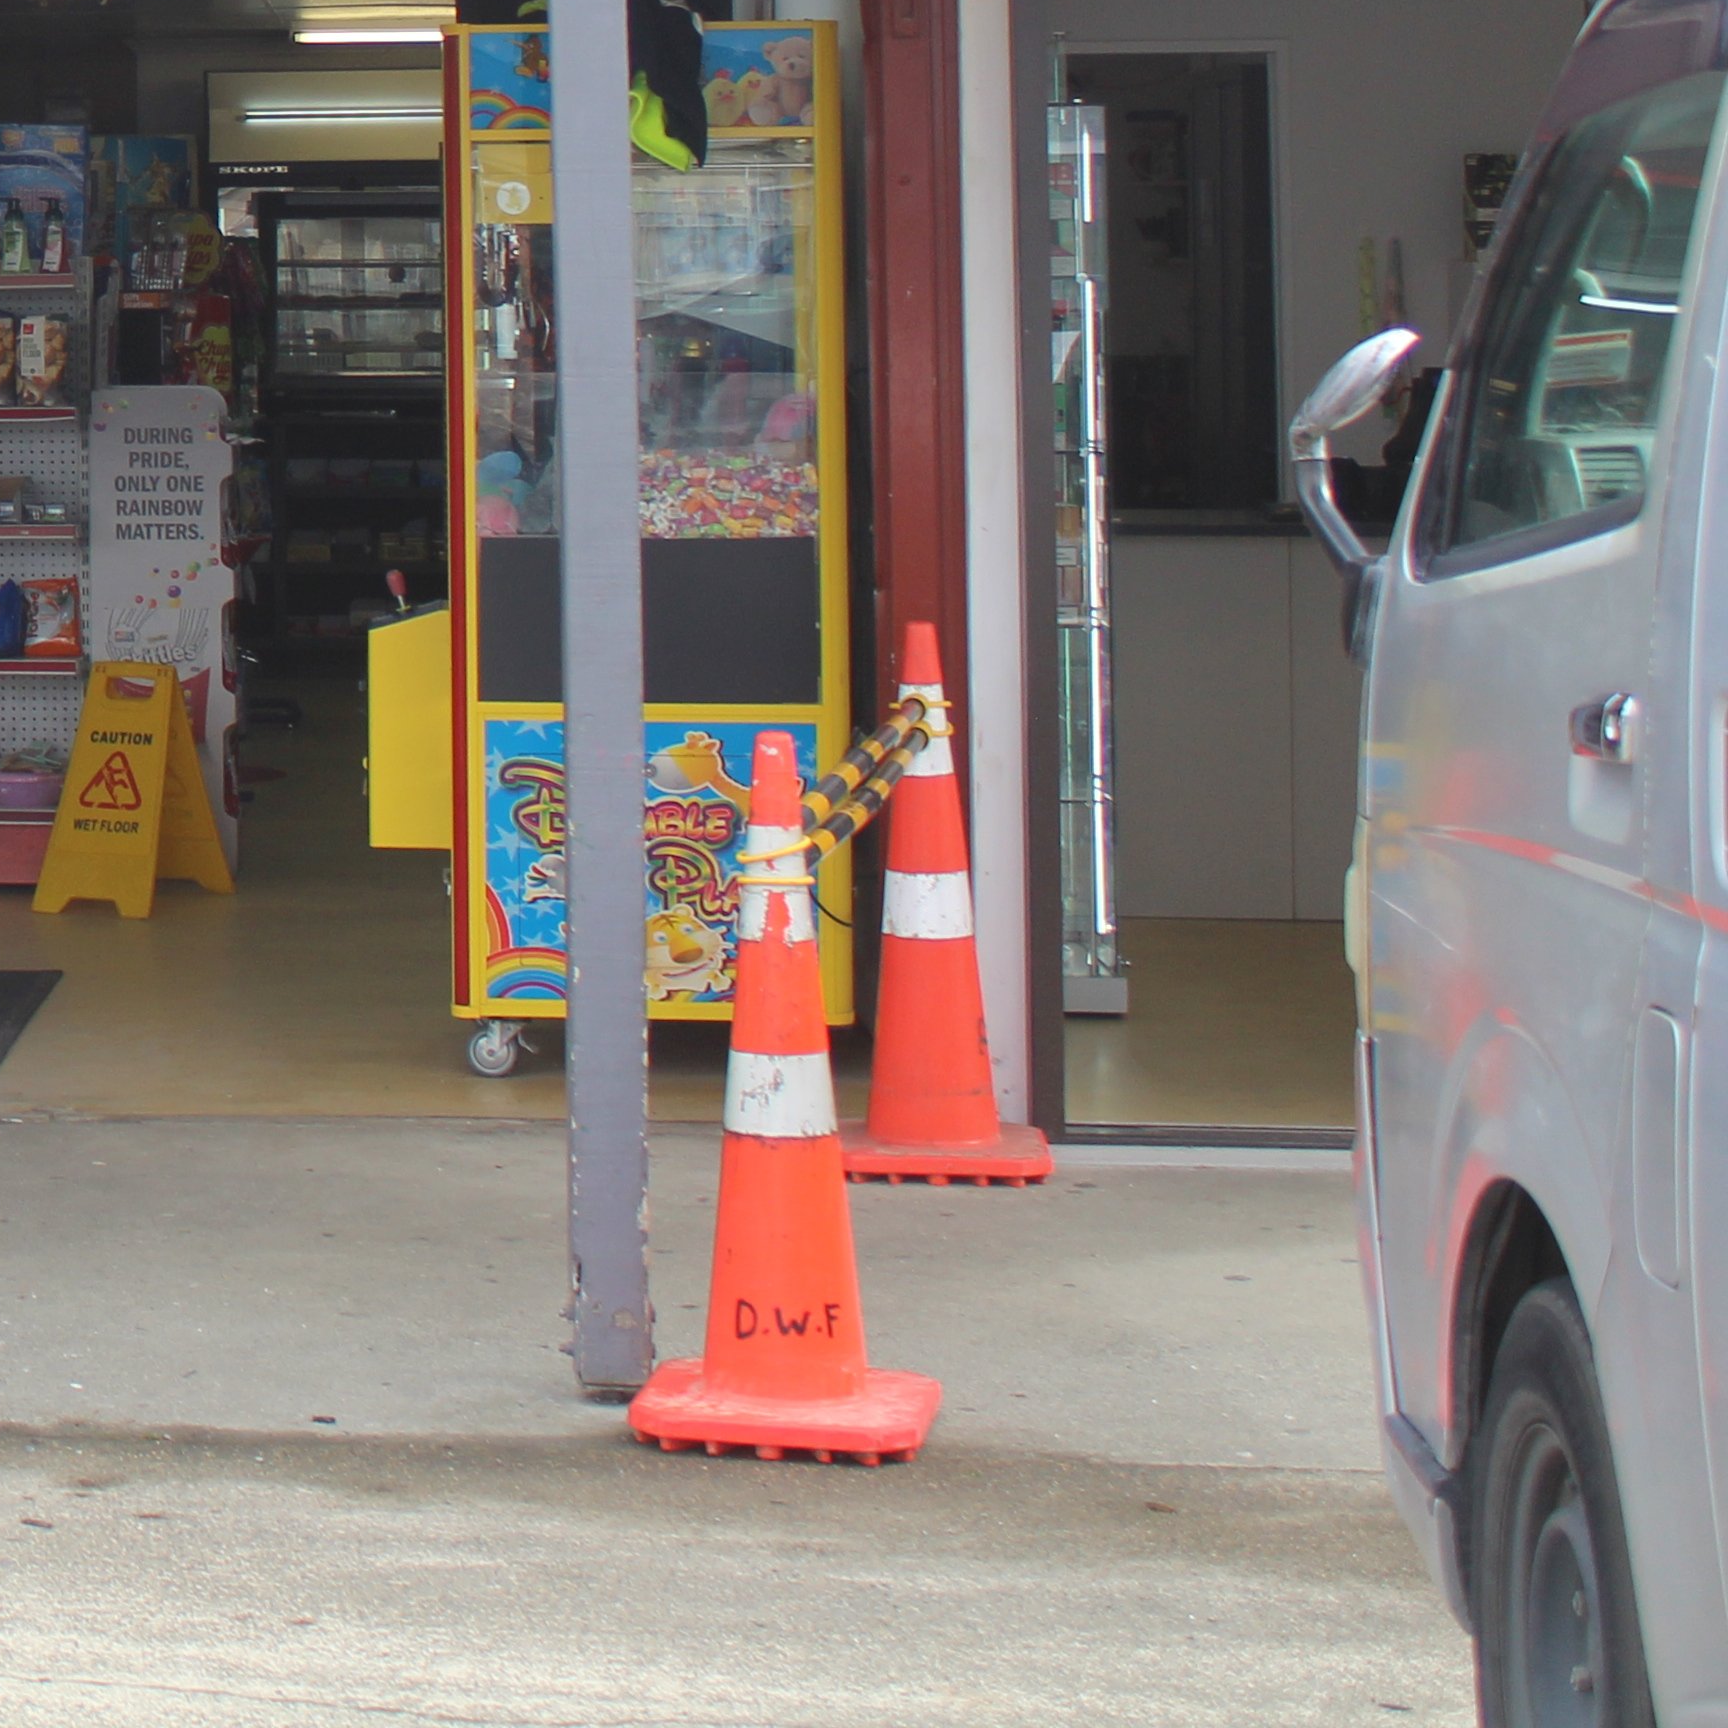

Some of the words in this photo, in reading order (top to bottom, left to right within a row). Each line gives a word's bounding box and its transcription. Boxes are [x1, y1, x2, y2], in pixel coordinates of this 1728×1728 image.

[123, 428, 193, 445] DURING
[128, 452, 190, 471] PRIDE,
[114, 476, 160, 493] ONLY
[165, 476, 204, 493] ONE
[115, 500, 204, 517] RAINBOW
[115, 524, 205, 541] MATTERS.
[90, 730, 153, 746] CAUTION
[74, 819, 98, 833] WET
[100, 820, 140, 834] FLOOR
